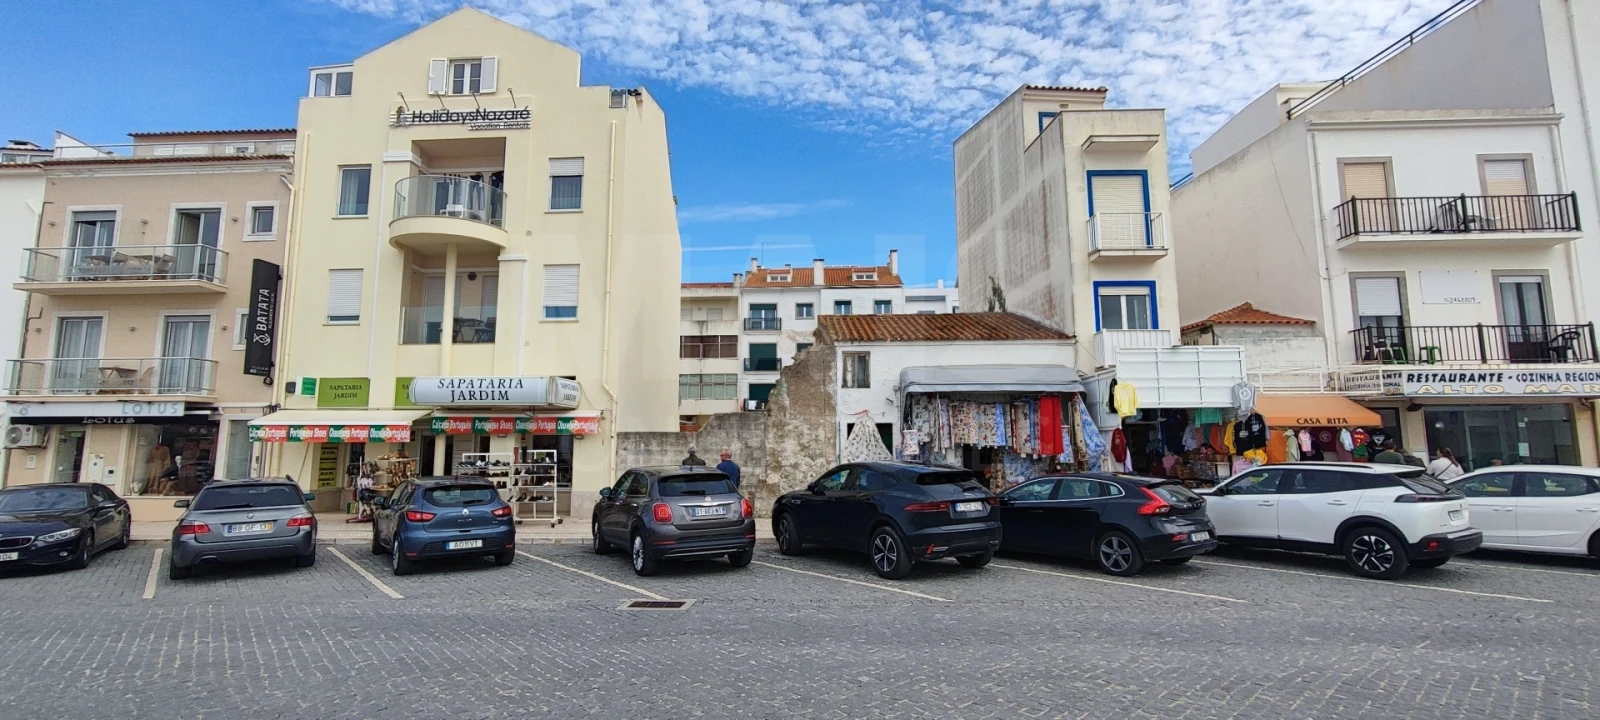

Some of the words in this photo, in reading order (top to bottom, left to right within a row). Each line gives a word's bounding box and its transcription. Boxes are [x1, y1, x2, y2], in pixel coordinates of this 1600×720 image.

[256, 288, 270, 331] BATATA
[1406, 372, 1504, 383] RESTAURANTE
[1516, 372, 1562, 382] COZINHA
[437, 378, 524, 389] SAPATARIA
[1416, 384, 1505, 395] ALTO
[1523, 383, 1600, 394] MAR
[333, 392, 358, 400] JARDIM
[450, 390, 510, 402] JARDIM
[121, 402, 178, 415] LOTUS
[500, 419, 514, 430] Shoes
[1296, 417, 1322, 425] CASA
[1326, 417, 1349, 425] RITA
[314, 427, 328, 438] Shoes
